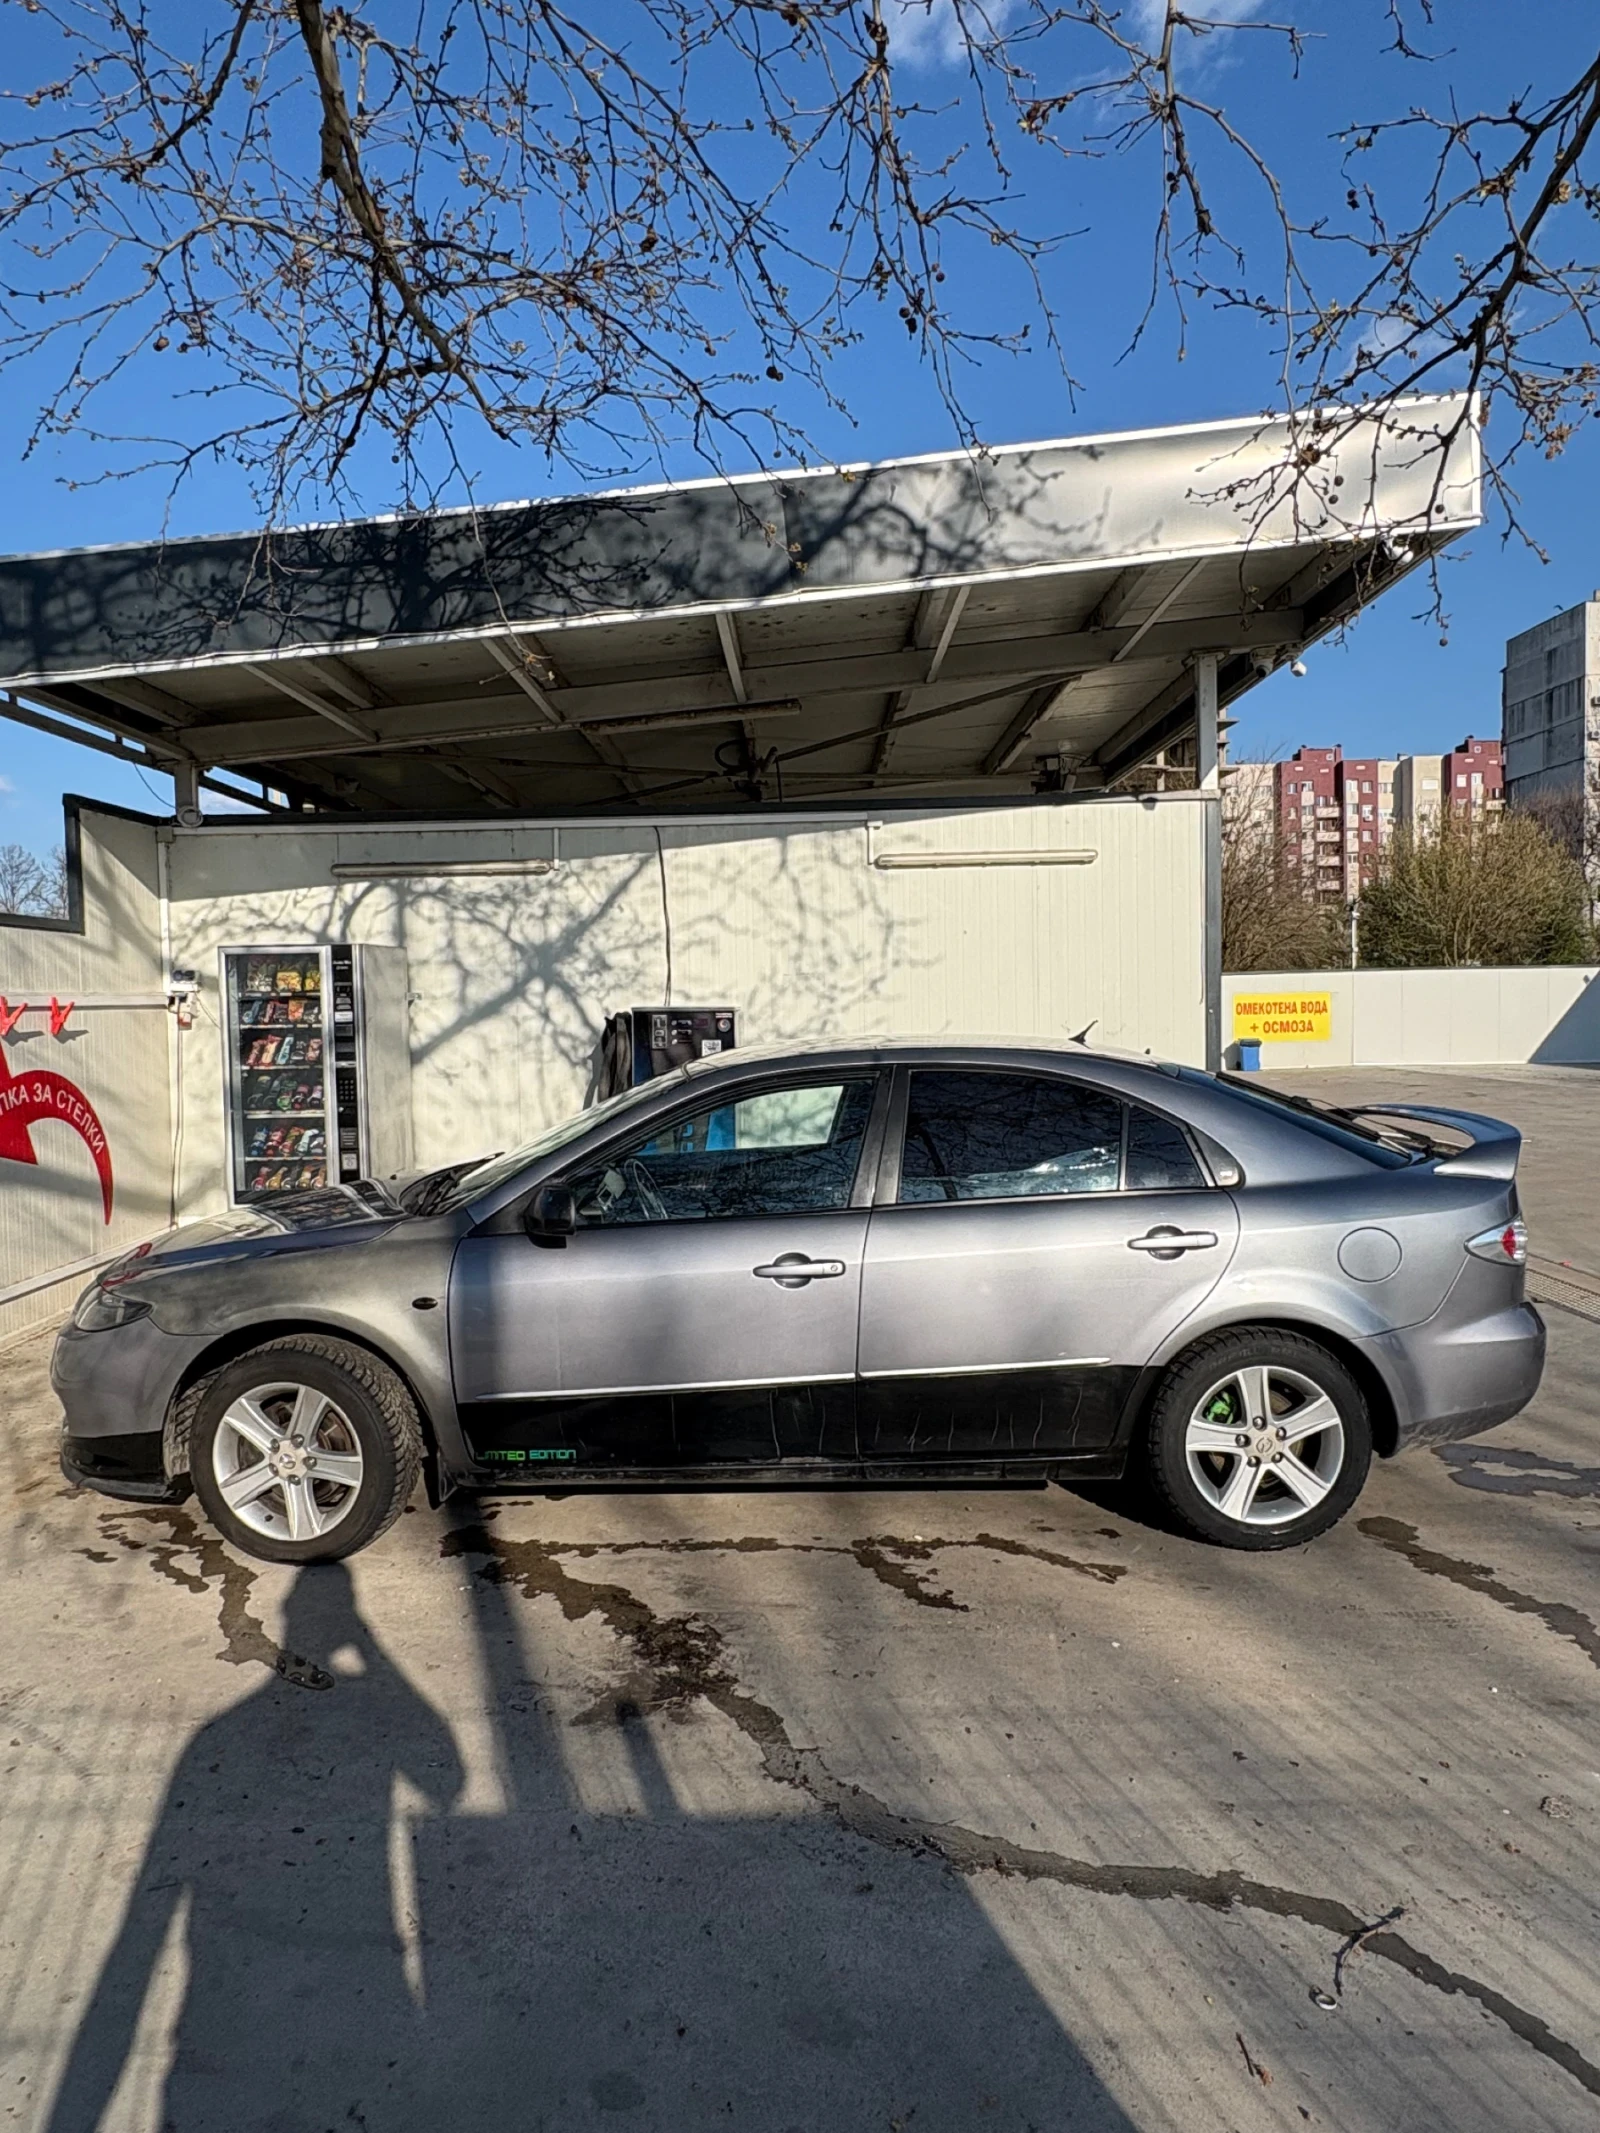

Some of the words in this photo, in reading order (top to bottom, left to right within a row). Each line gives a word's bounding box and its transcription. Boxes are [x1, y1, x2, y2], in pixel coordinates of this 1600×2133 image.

[1235, 1001, 1298, 1016] ОМЕКОТЕНА
[1300, 1000, 1328, 1015] ВОДА
[1263, 1019, 1314, 1034] ОСМОЗА
[33, 1082, 53, 1104] ЗА
[56, 1089, 105, 1154] СТЕЛКИ
[529, 1449, 577, 1460] EDITION
